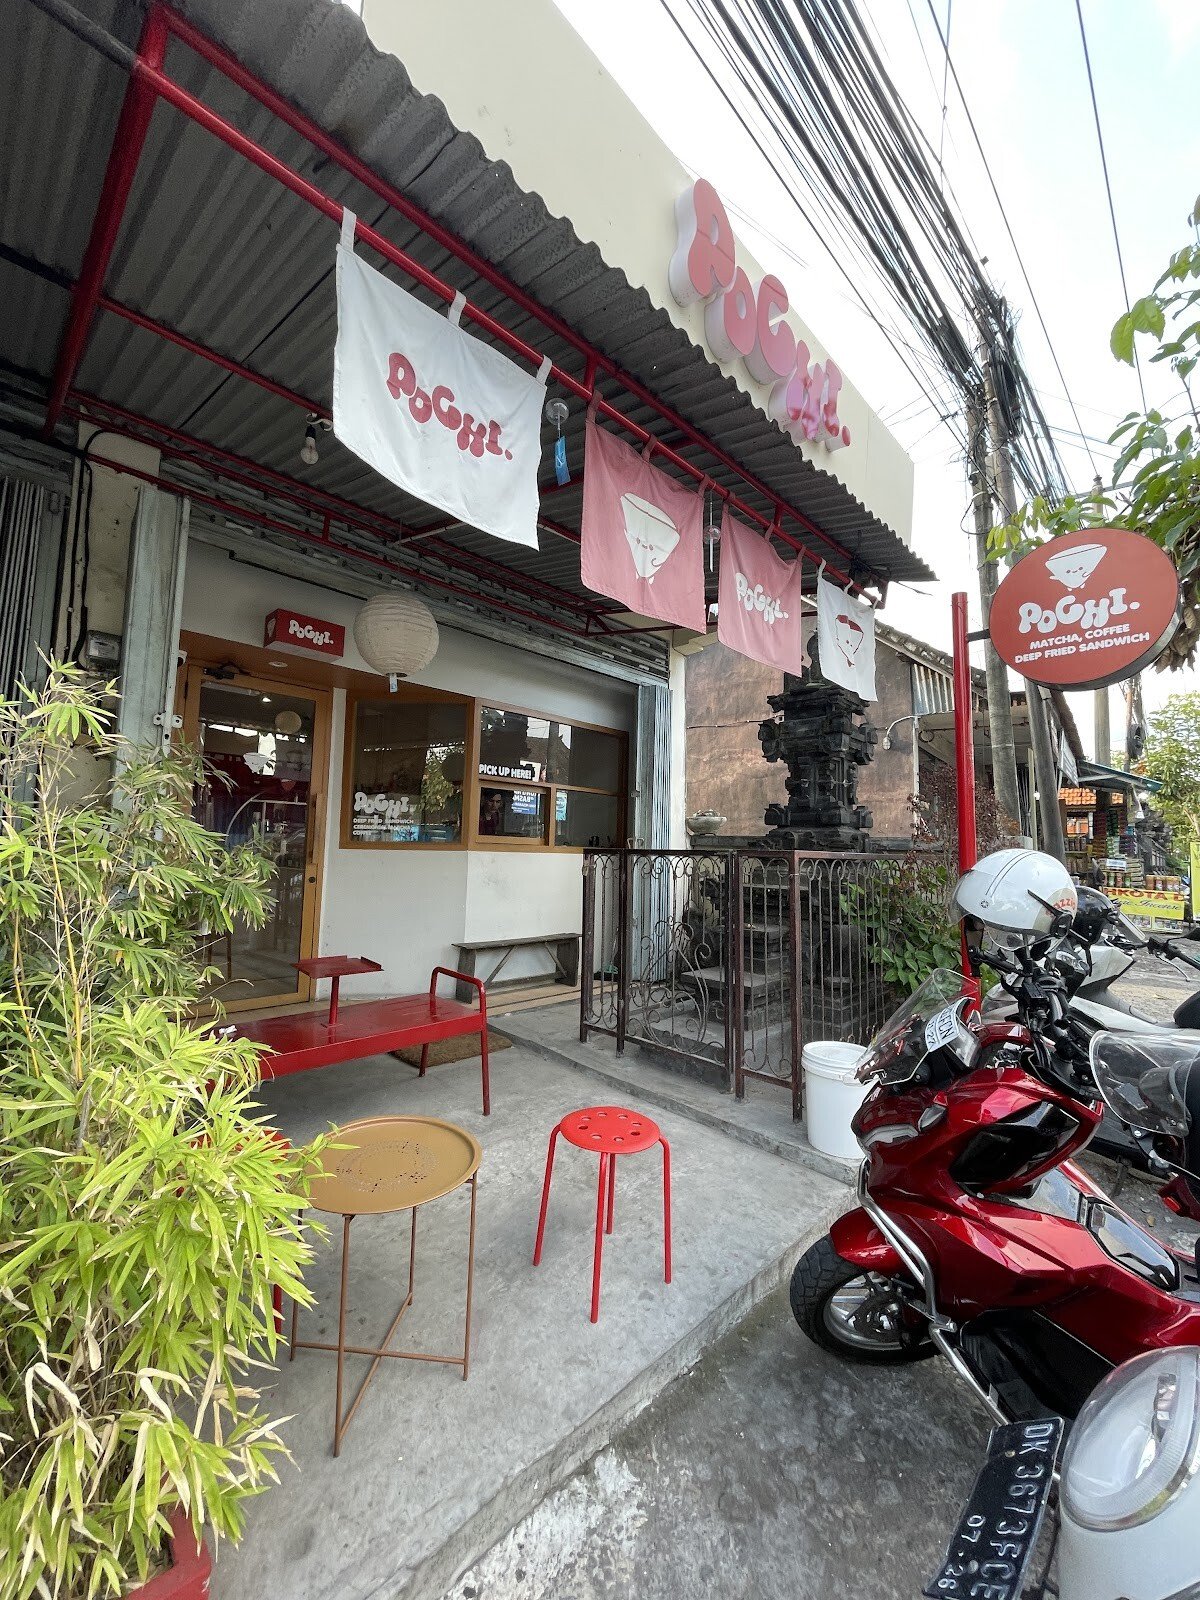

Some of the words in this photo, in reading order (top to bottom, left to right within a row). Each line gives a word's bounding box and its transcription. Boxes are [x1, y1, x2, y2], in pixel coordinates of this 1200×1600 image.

[386, 352, 513, 461] POCHI.
[735, 572, 789, 625] POCHI.
[1018, 587, 1141, 634] POCHI.
[288, 619, 335, 646] POCHI.
[1014, 652, 1043, 664] DEEP
[1044, 645, 1077, 659] FRIED
[1078, 632, 1150, 652] SANDWICH
[1029, 633, 1083, 650] MATCHA,
[1084, 623, 1131, 640] COFFEE
[478, 763, 498, 776] PICK
[498, 765, 510, 777] UP
[510, 768, 532, 780] HERE!
[1018, 1423, 1054, 1456] DK
[995, 1464, 1044, 1536] 3673
